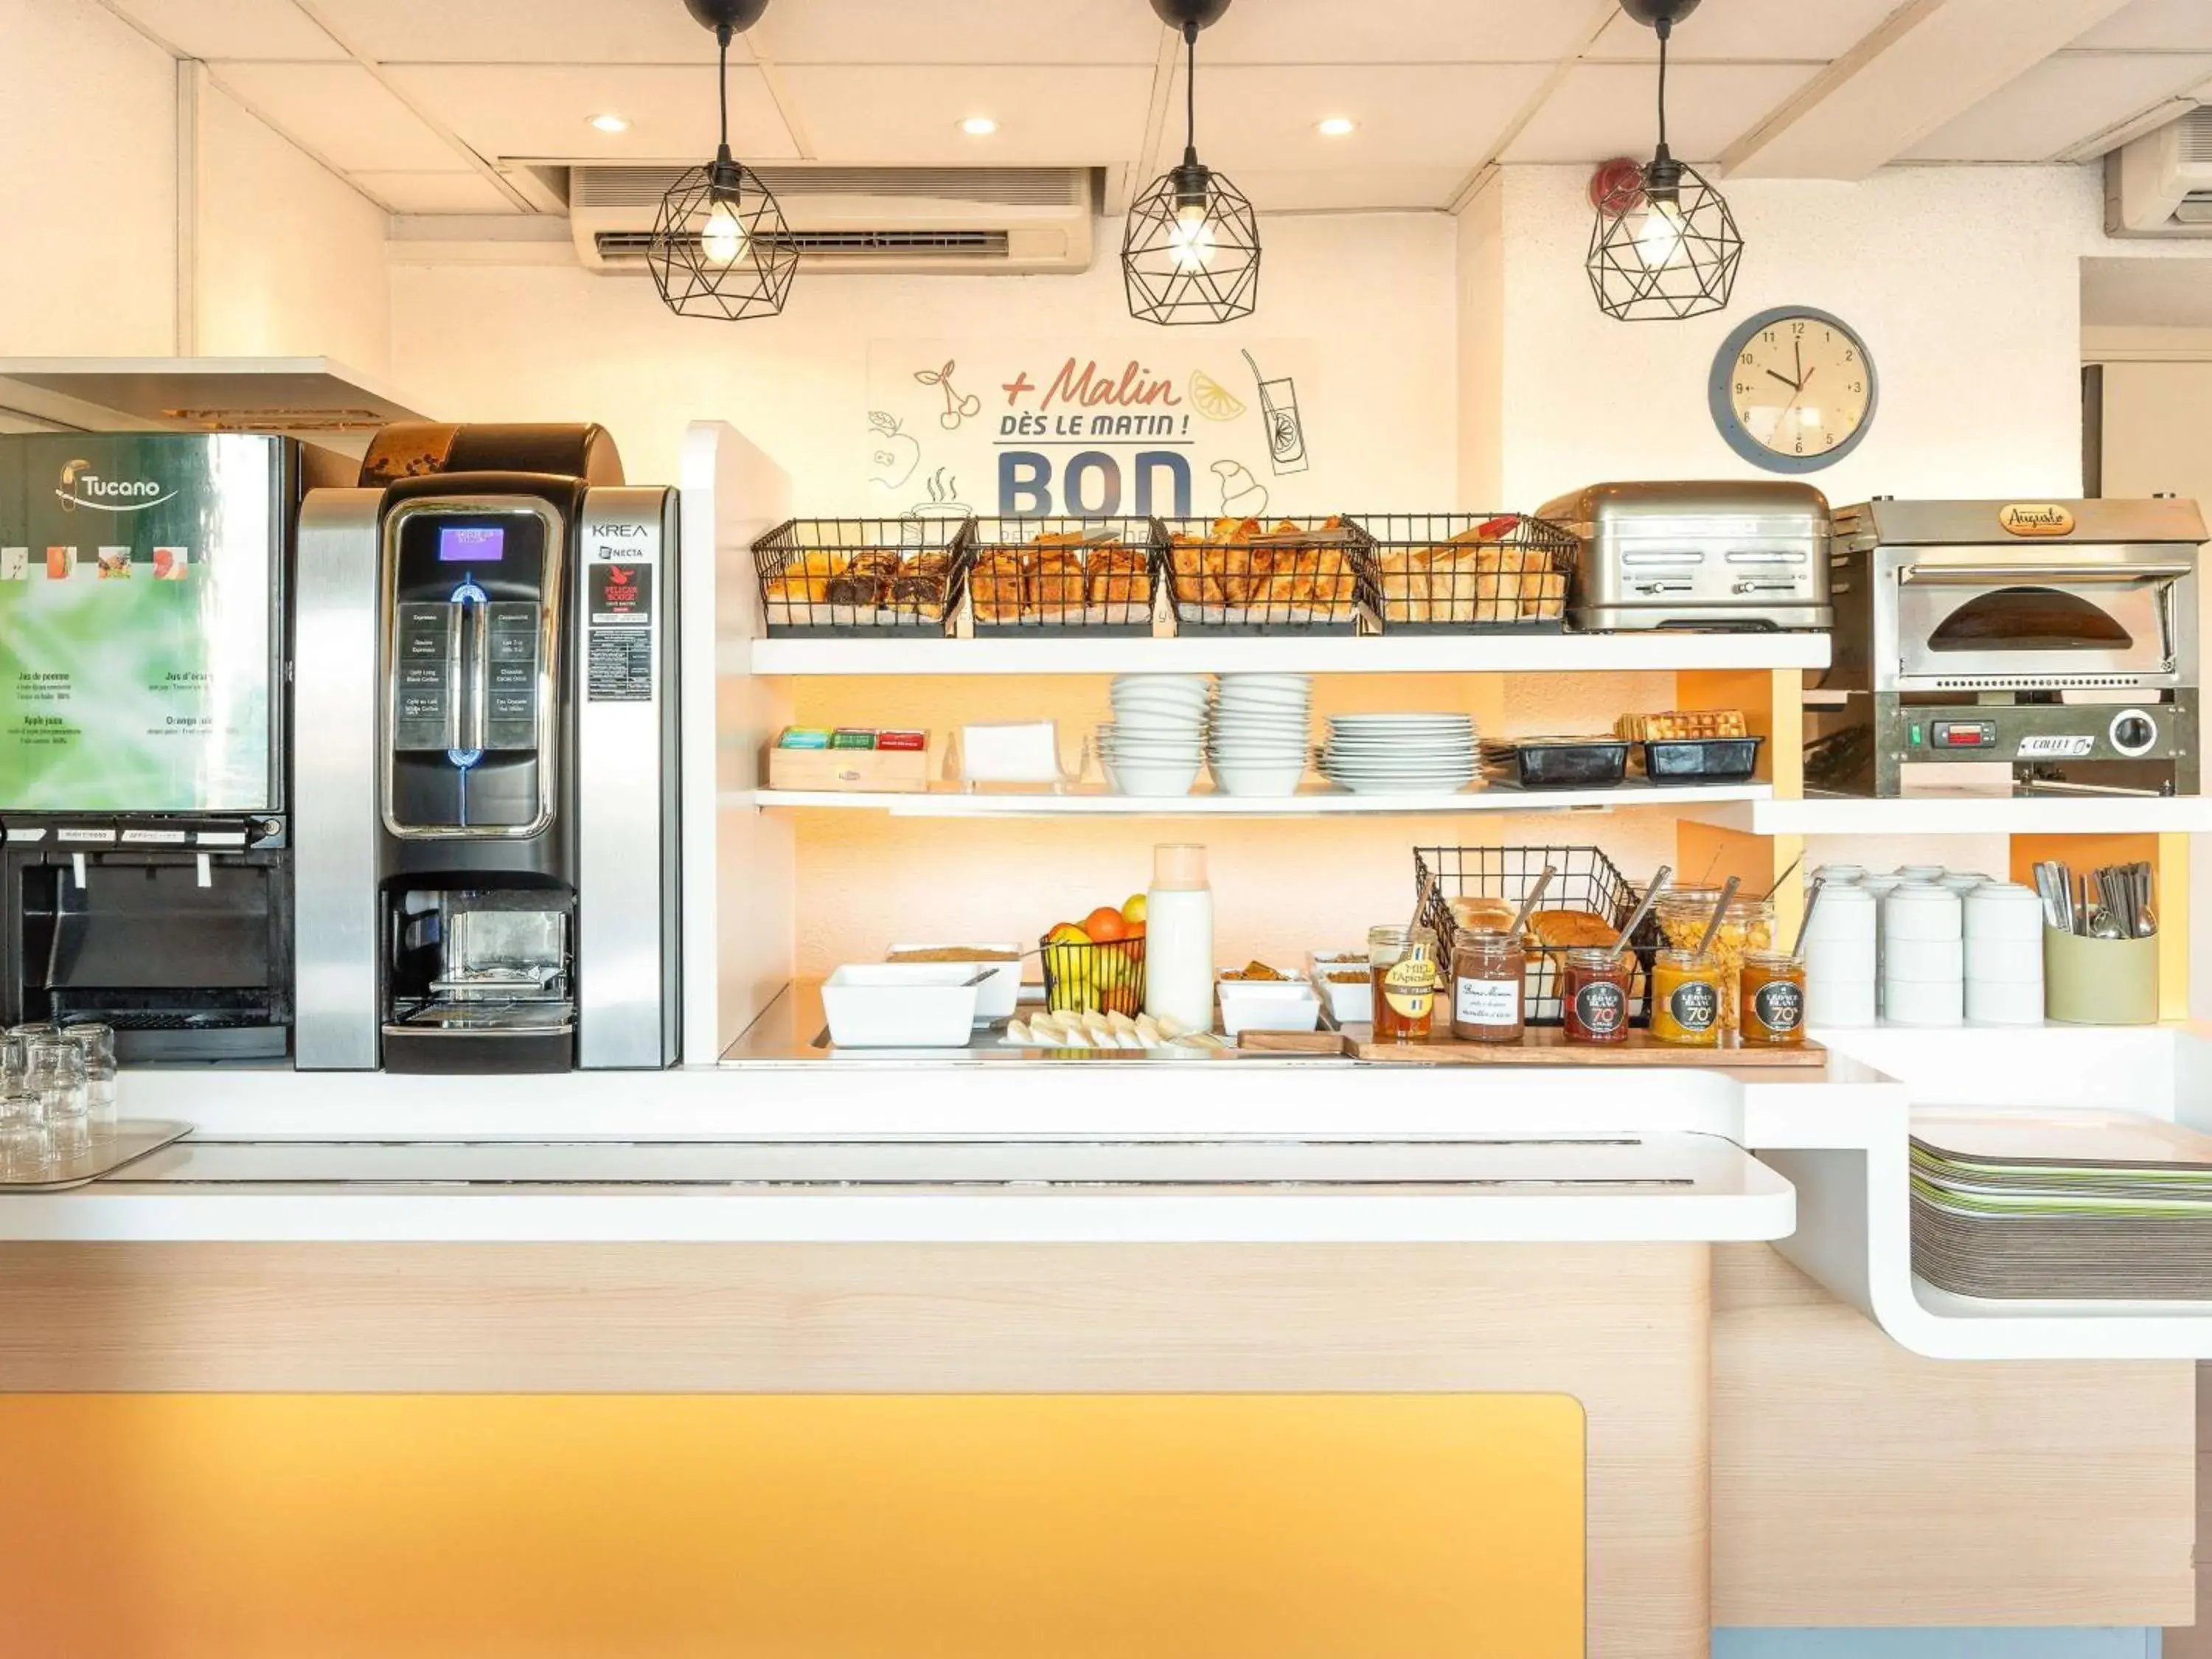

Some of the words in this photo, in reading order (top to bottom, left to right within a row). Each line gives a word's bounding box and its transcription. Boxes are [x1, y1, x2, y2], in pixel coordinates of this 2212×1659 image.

[1792, 323, 1804, 334] 12
[1764, 333, 1775, 342] 11
[1826, 332, 1830, 342] 1
[1740, 353, 1753, 364] 10
[1846, 350, 1853, 361] 2
[1040, 357, 1182, 412] Malin
[1736, 383, 1743, 394] 9
[1854, 382, 1862, 393] 3
[1000, 411, 1048, 436] DÈS
[1055, 415, 1083, 436] LE
[1091, 415, 1174, 436] MATIN
[1826, 433, 1834, 444] 5
[1795, 442, 1803, 453] 6
[81, 476, 161, 496] Tucano
[998, 451, 1192, 523] BON
[2008, 507, 2063, 528] Augusto
[592, 524, 648, 537] KREA
[613, 549, 643, 557] NECTA
[165, 672, 181, 681] Jus
